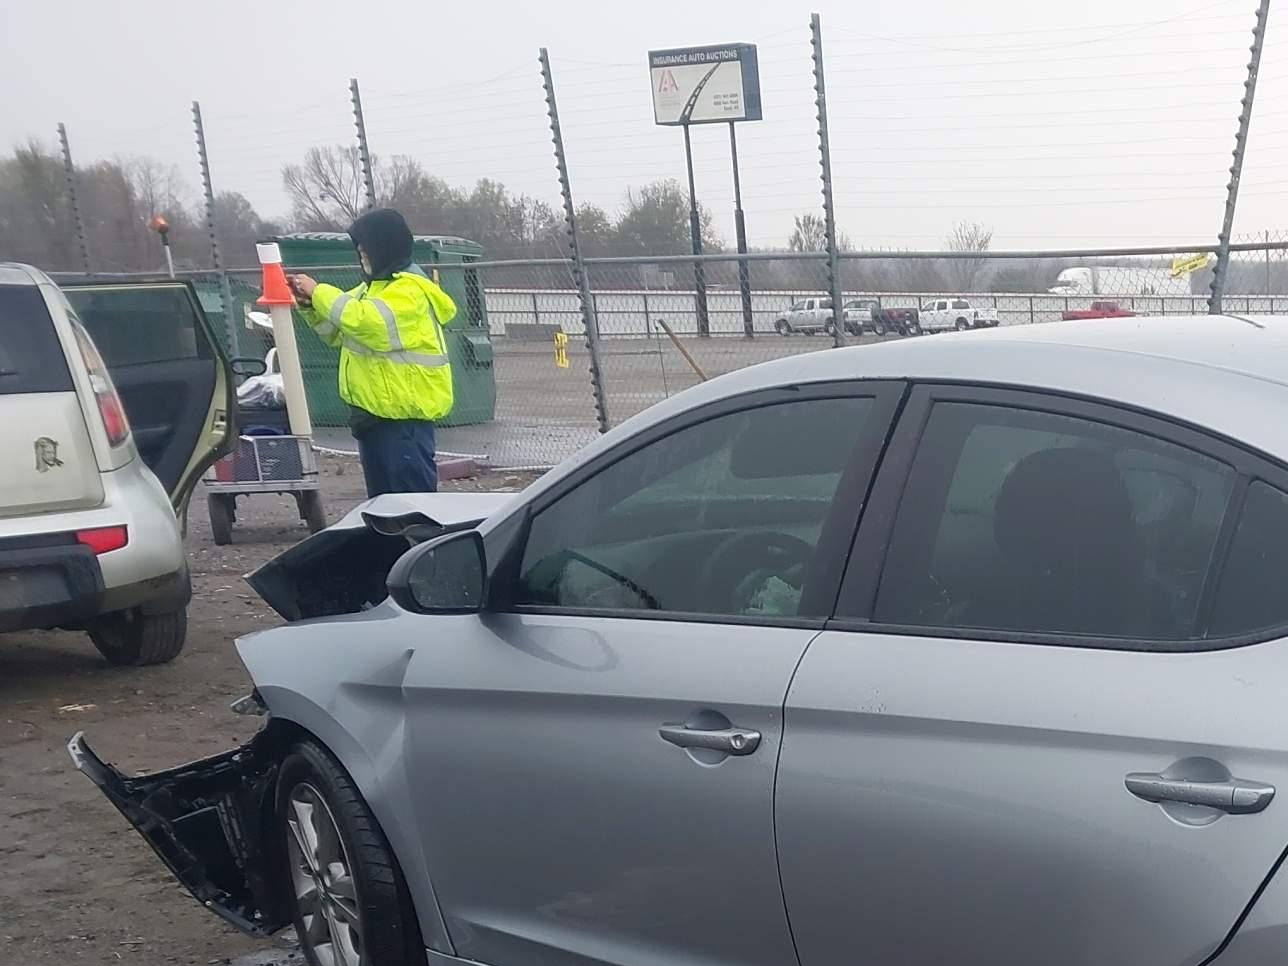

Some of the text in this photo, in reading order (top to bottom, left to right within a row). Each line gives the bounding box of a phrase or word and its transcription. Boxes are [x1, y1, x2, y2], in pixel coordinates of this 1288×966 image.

[653, 49, 738, 65] INSURANCE AUTO AUCTIONS
